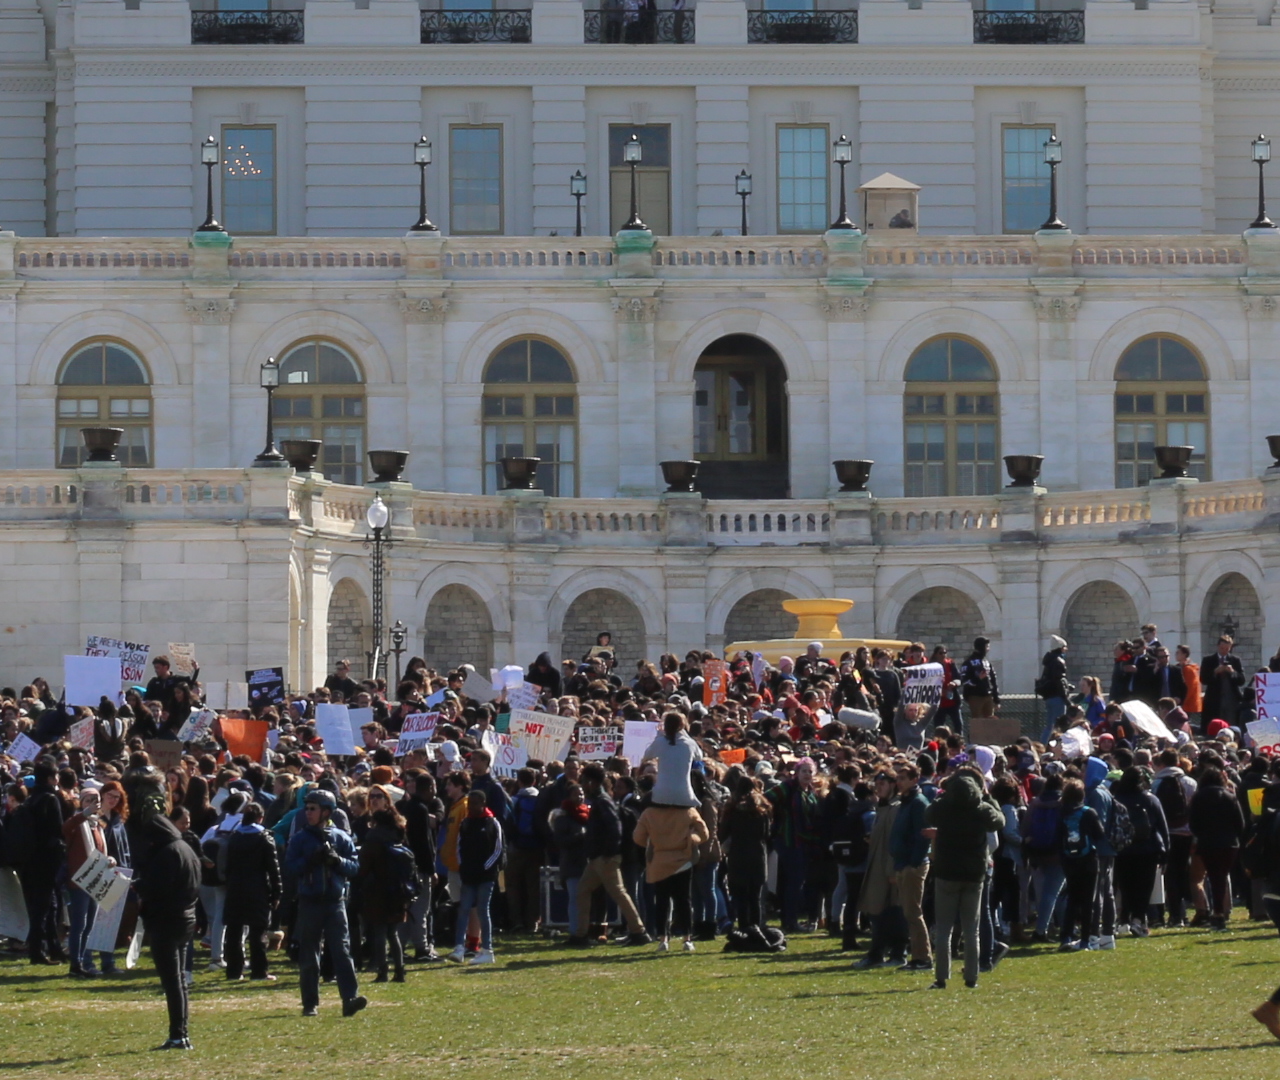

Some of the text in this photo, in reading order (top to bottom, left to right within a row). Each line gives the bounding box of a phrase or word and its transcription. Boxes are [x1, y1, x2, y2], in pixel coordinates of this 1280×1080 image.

[124, 641, 150, 652] VOICE
[908, 668, 926, 679] NO
[904, 685, 942, 705] SCHOOLS
[525, 722, 545, 736] NOT
